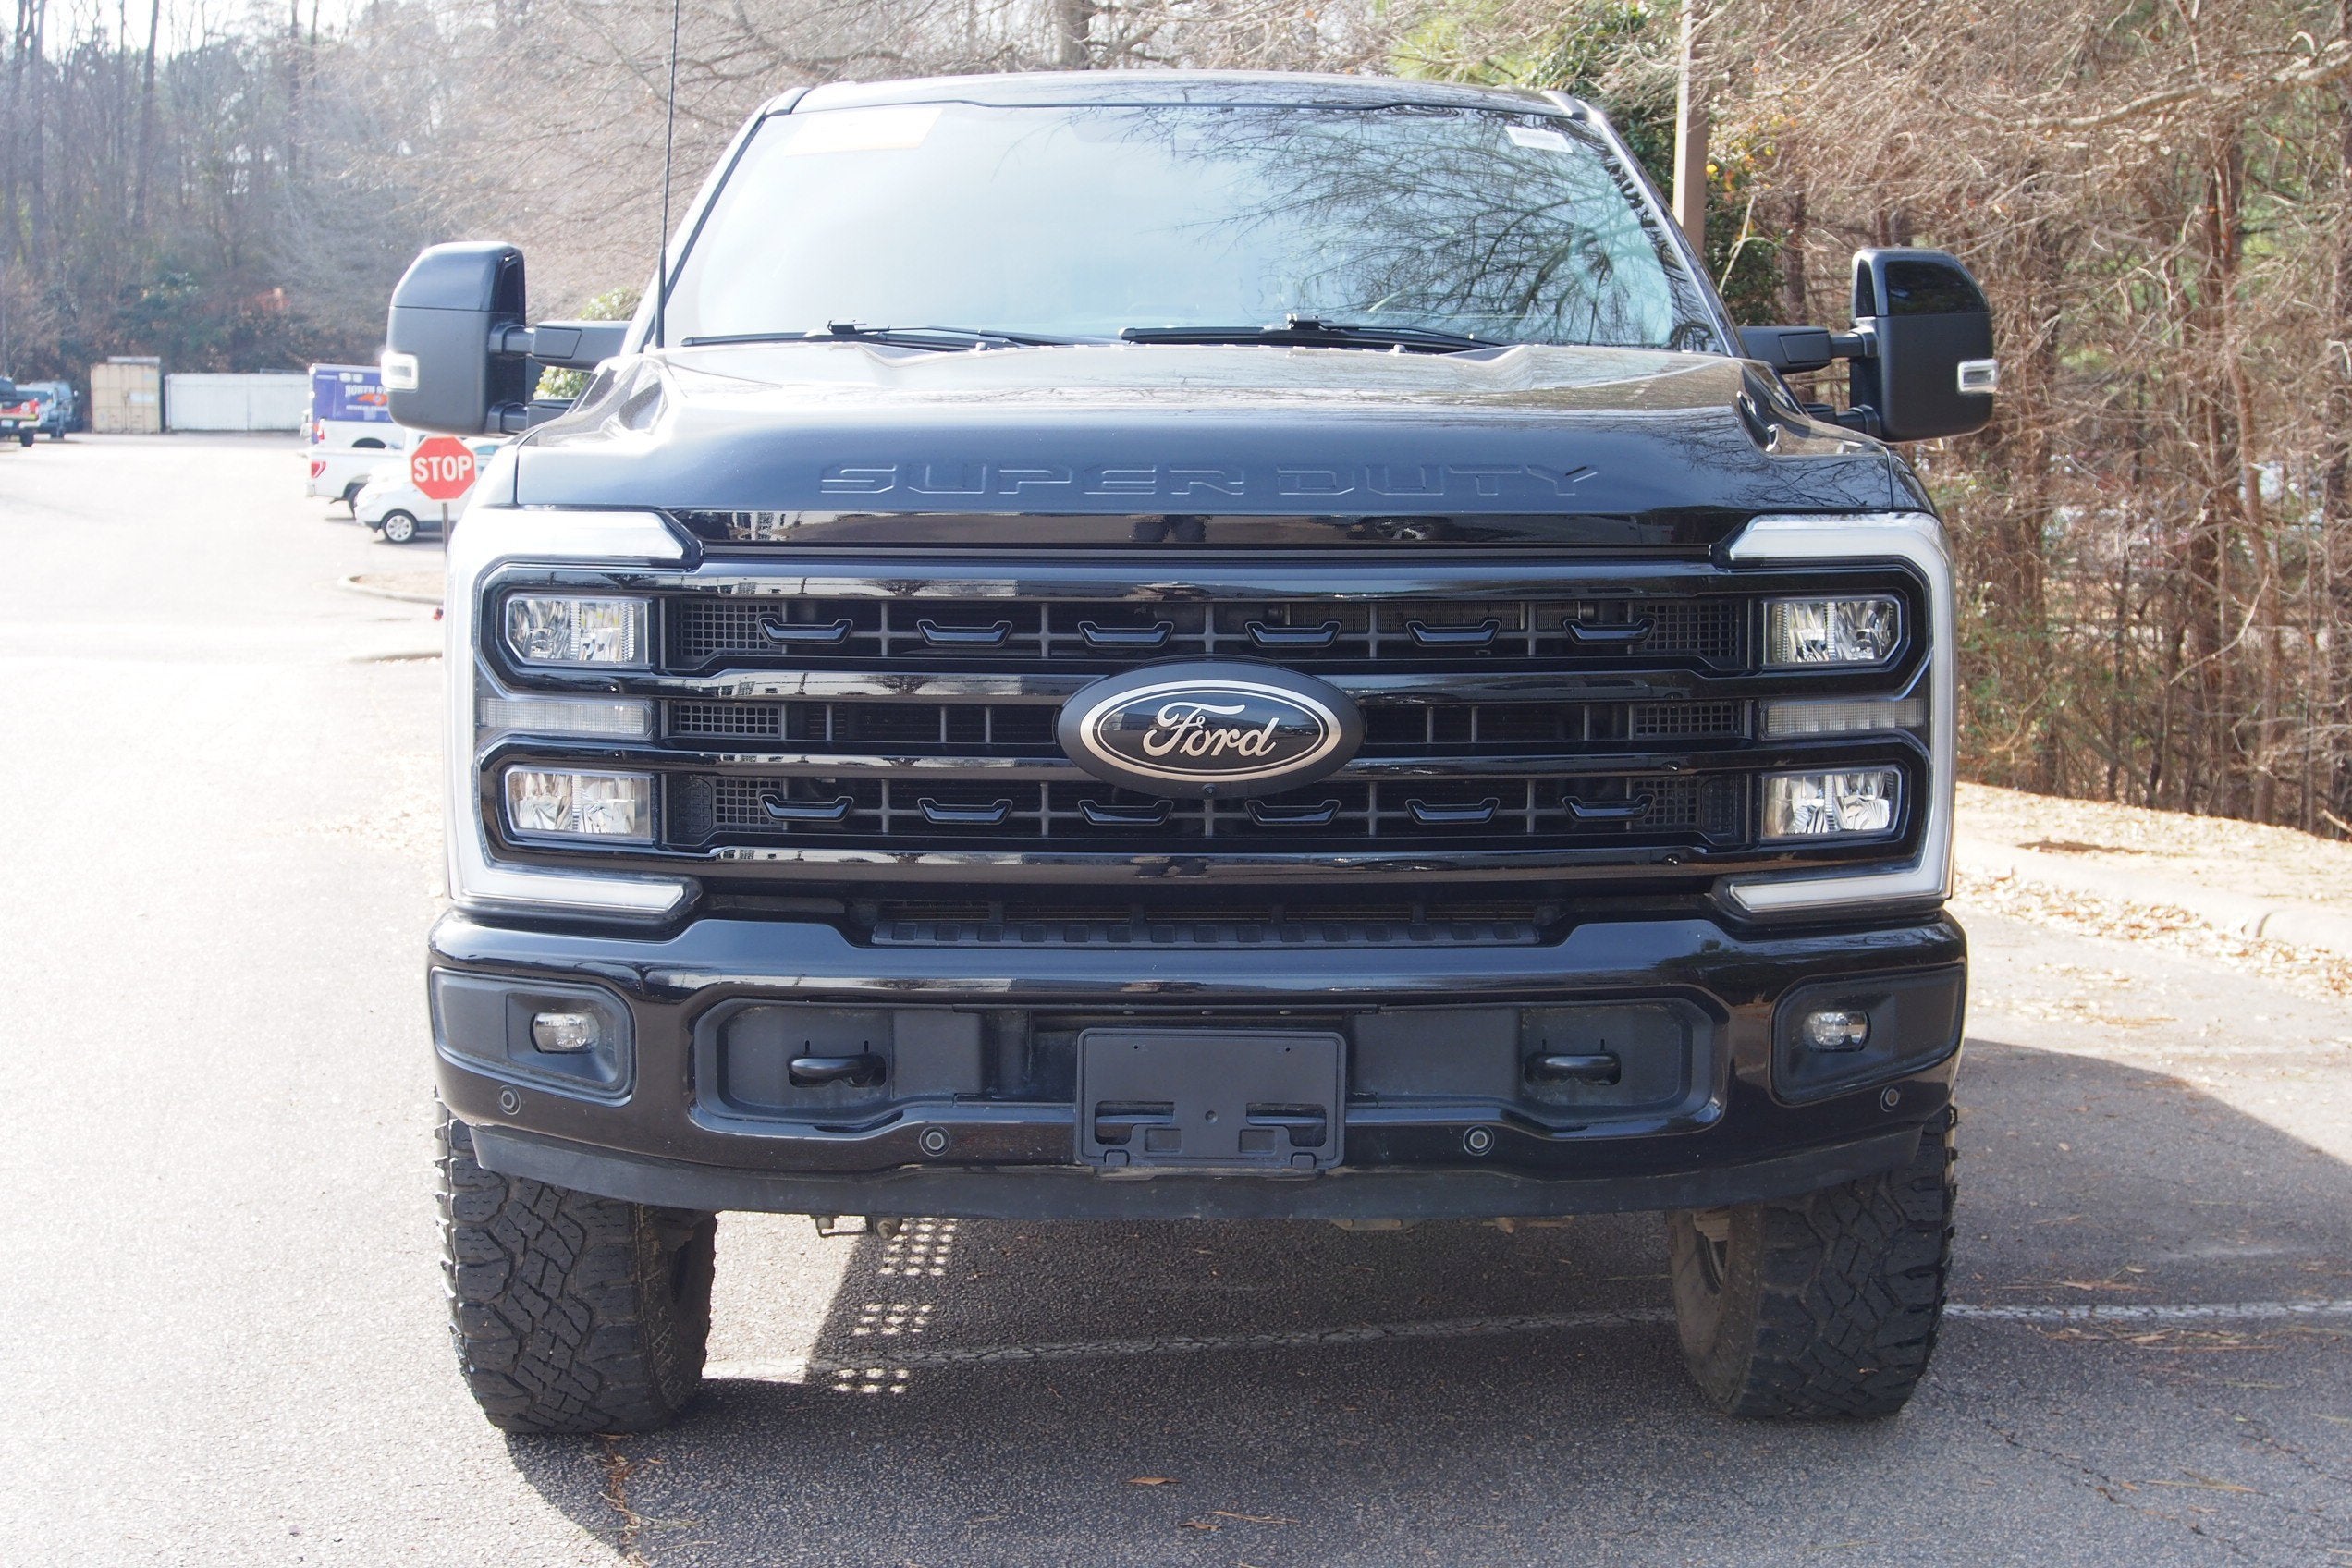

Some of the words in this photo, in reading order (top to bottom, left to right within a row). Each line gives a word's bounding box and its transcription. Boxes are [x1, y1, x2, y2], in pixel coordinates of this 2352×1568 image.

[345, 385, 376, 397] NORTH
[414, 455, 472, 482] STOP
[821, 464, 1244, 494] SUPER
[1277, 465, 1599, 496] DUTY
[1143, 702, 1280, 756] Ford
